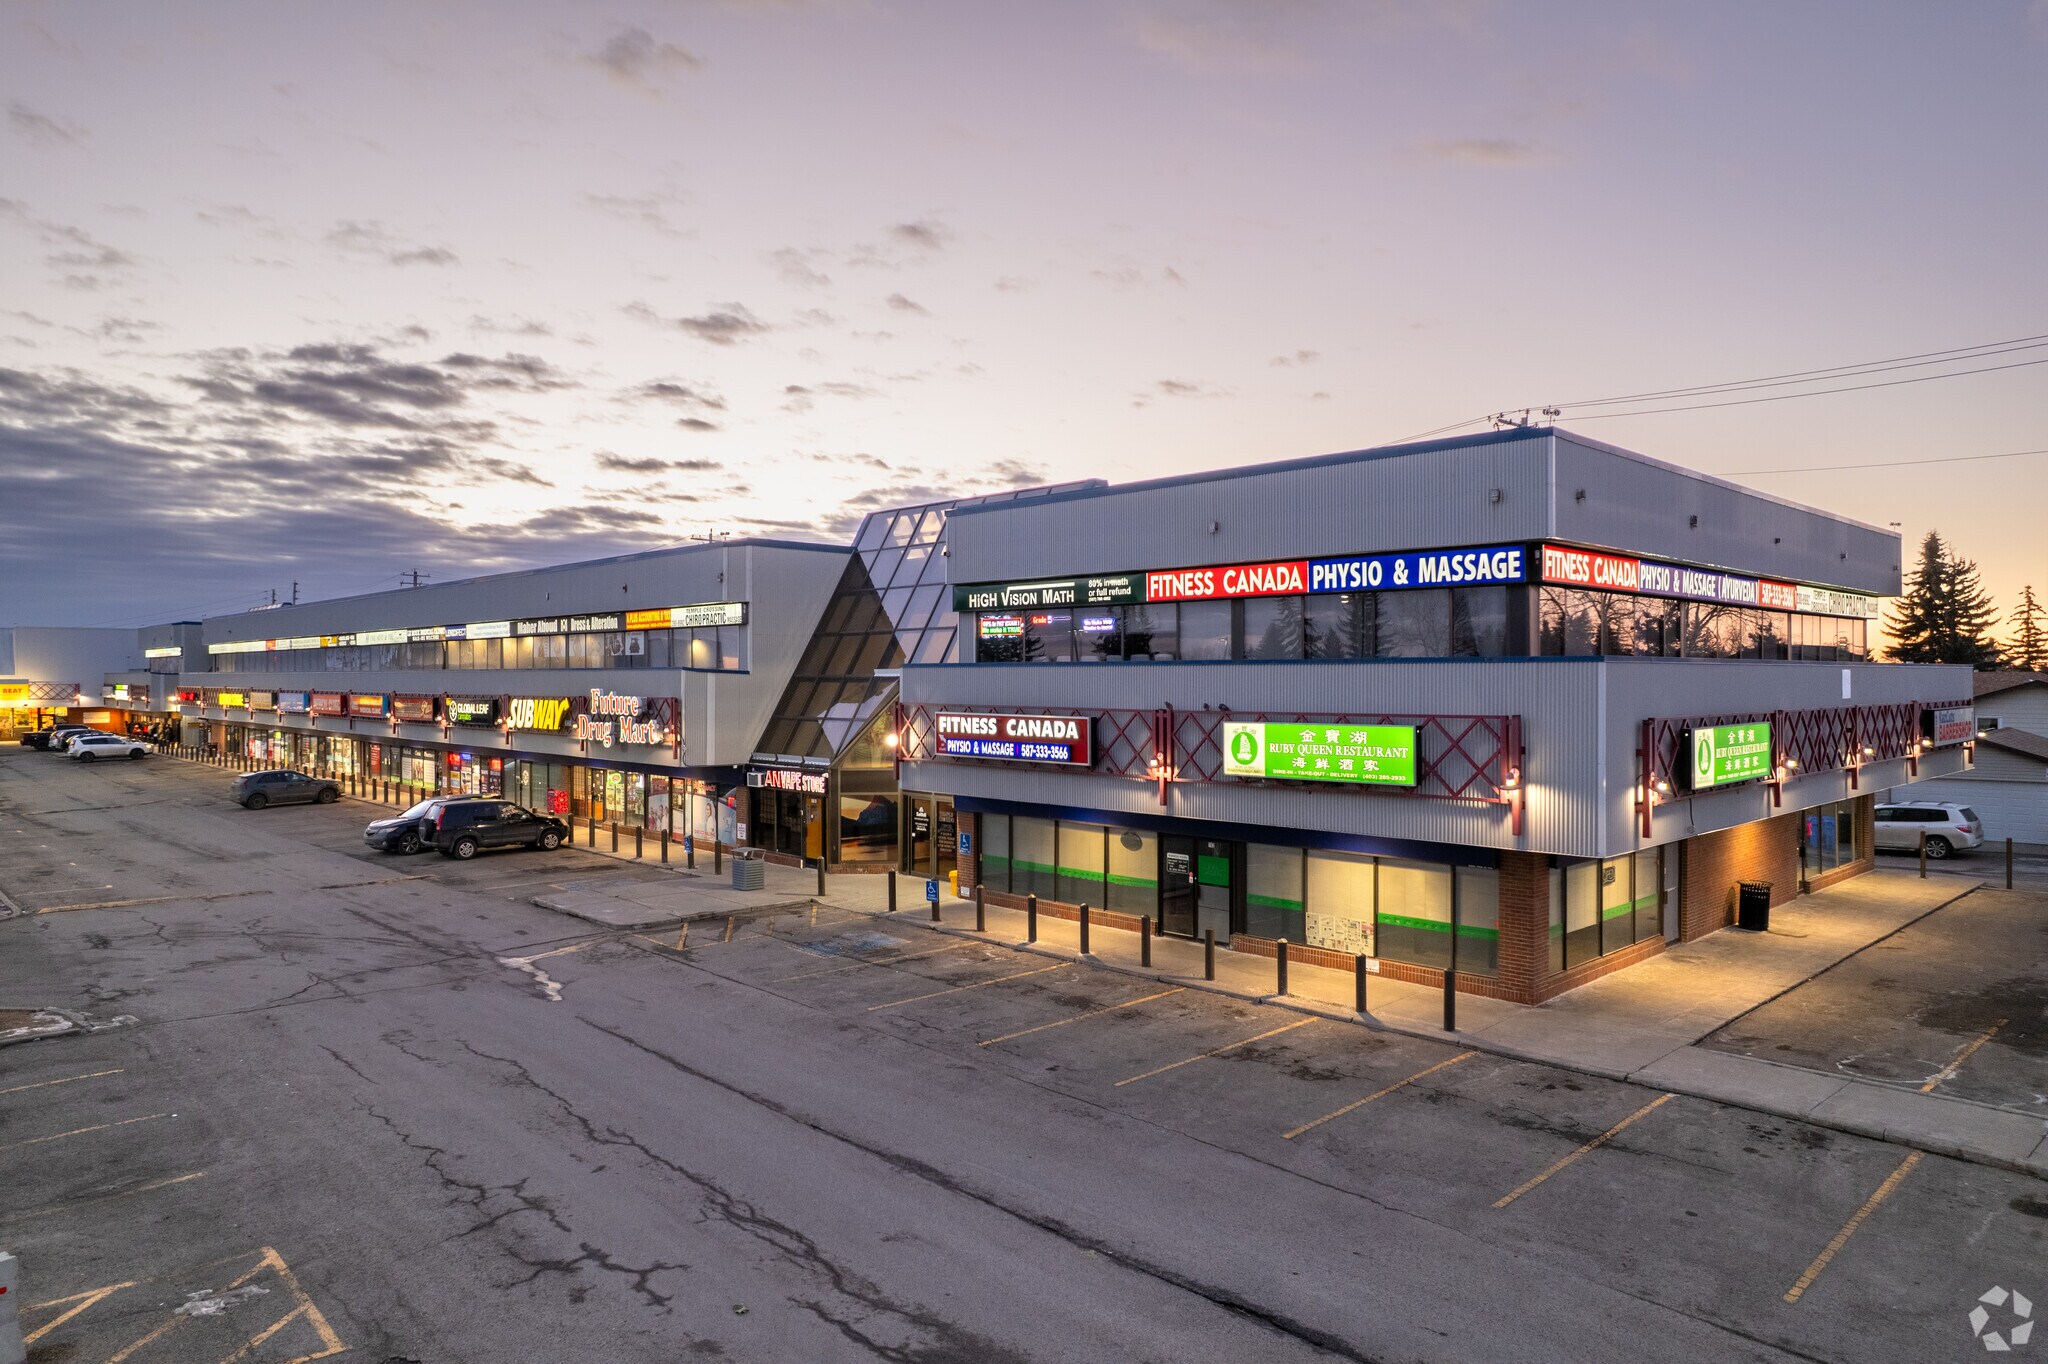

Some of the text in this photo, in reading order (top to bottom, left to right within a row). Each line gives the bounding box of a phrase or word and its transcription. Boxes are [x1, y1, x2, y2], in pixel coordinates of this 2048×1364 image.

[1312, 550, 1522, 590] PHYSIO & MASSAGE
[1545, 549, 1638, 589] FITNESS CANADA
[1088, 578, 1103, 588] 80%
[1149, 565, 1304, 598] FITNESS CANADA
[1640, 564, 1671, 592] PHYSIO
[1673, 569, 1680, 593] &
[1682, 571, 1716, 598] MASSAGE
[1042, 588, 1075, 604] MATH
[1096, 587, 1108, 597] full
[1108, 586, 1132, 597] refund
[685, 605, 726, 614] TEMPLE CROSSING
[570, 618, 586, 632] Dress
[591, 615, 618, 631] Alteration
[685, 612, 727, 627] CHIROPRACTIC
[1032, 615, 1053, 625] Grade 5
[457, 702, 489, 715] GLOBAL LEAF
[590, 688, 639, 716] Future
[506, 697, 570, 730] SUBWAY
[578, 713, 656, 748] Drug Mart
[938, 715, 1079, 740] FITNESS CANADA
[1938, 720, 1972, 742] BARBERSHOP
[947, 739, 972, 754] PHYSIO
[973, 740, 980, 755] &
[981, 741, 1015, 757] MASSAGE
[1020, 744, 1069, 760] 587-333-3566
[1269, 743, 1409, 759] RUBY QUEEN RESTAURANT
[801, 775, 825, 793] STORE
